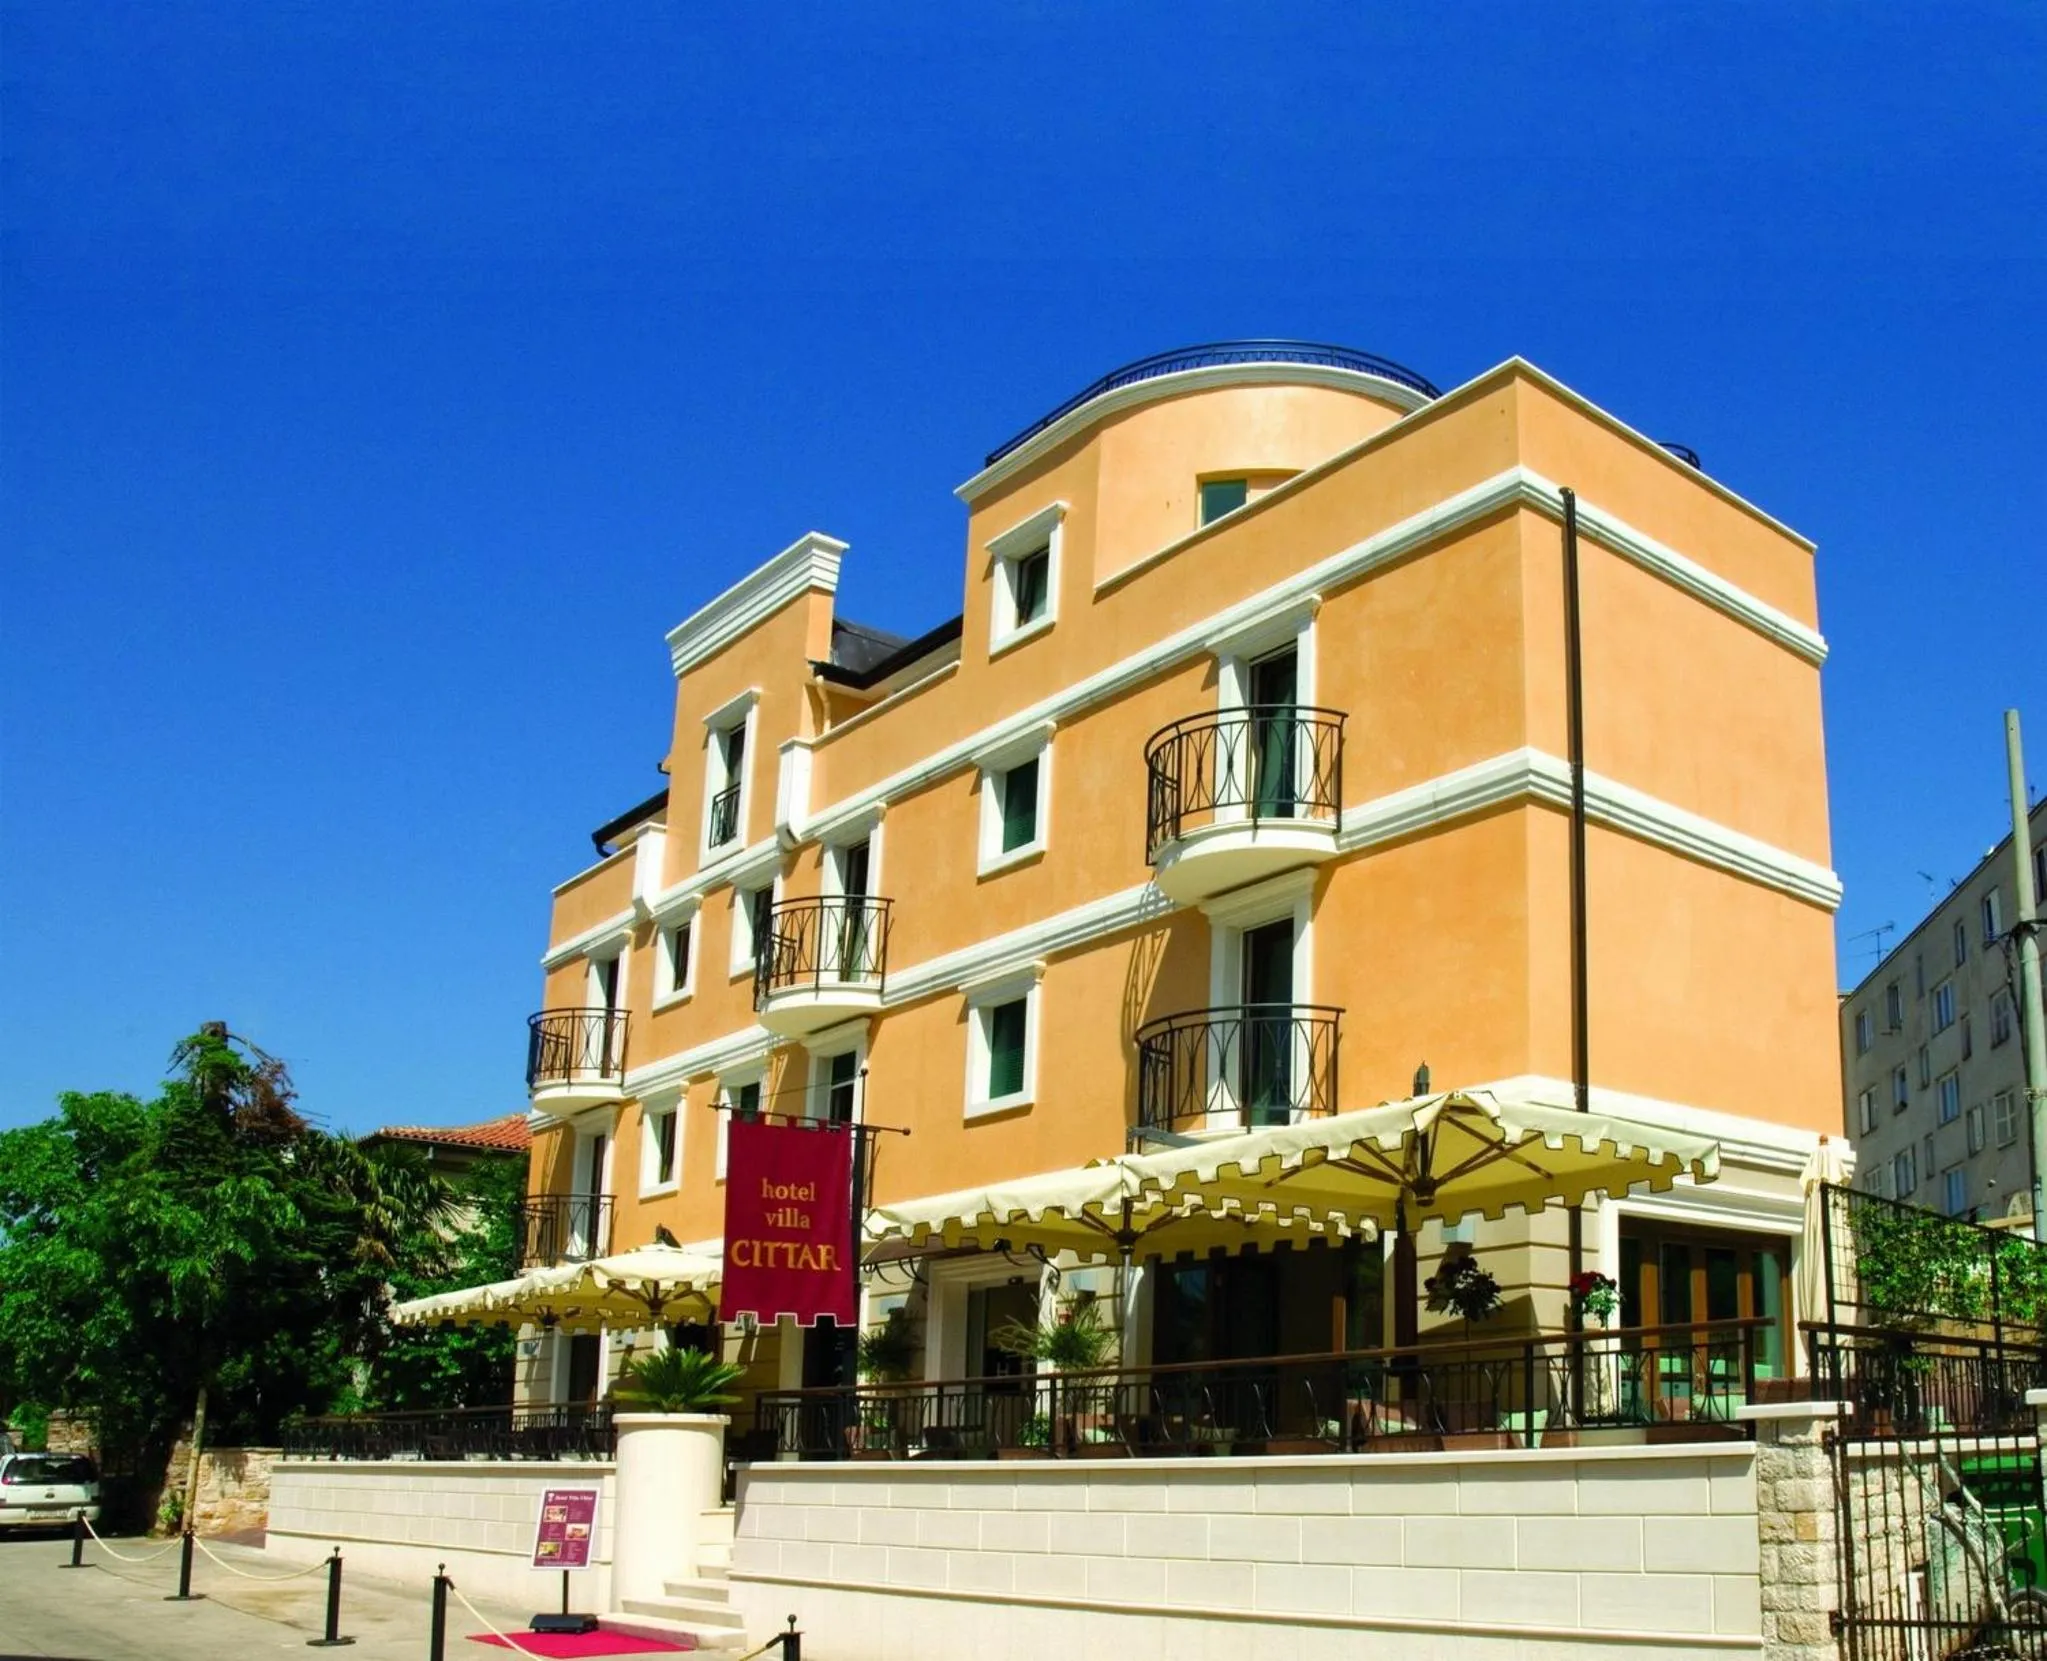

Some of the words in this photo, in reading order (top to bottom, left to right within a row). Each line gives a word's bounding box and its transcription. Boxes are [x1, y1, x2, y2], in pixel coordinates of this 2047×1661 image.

[762, 1178, 816, 1202] hotel
[764, 1207, 811, 1230] villa
[730, 1239, 842, 1272] CITTAR
